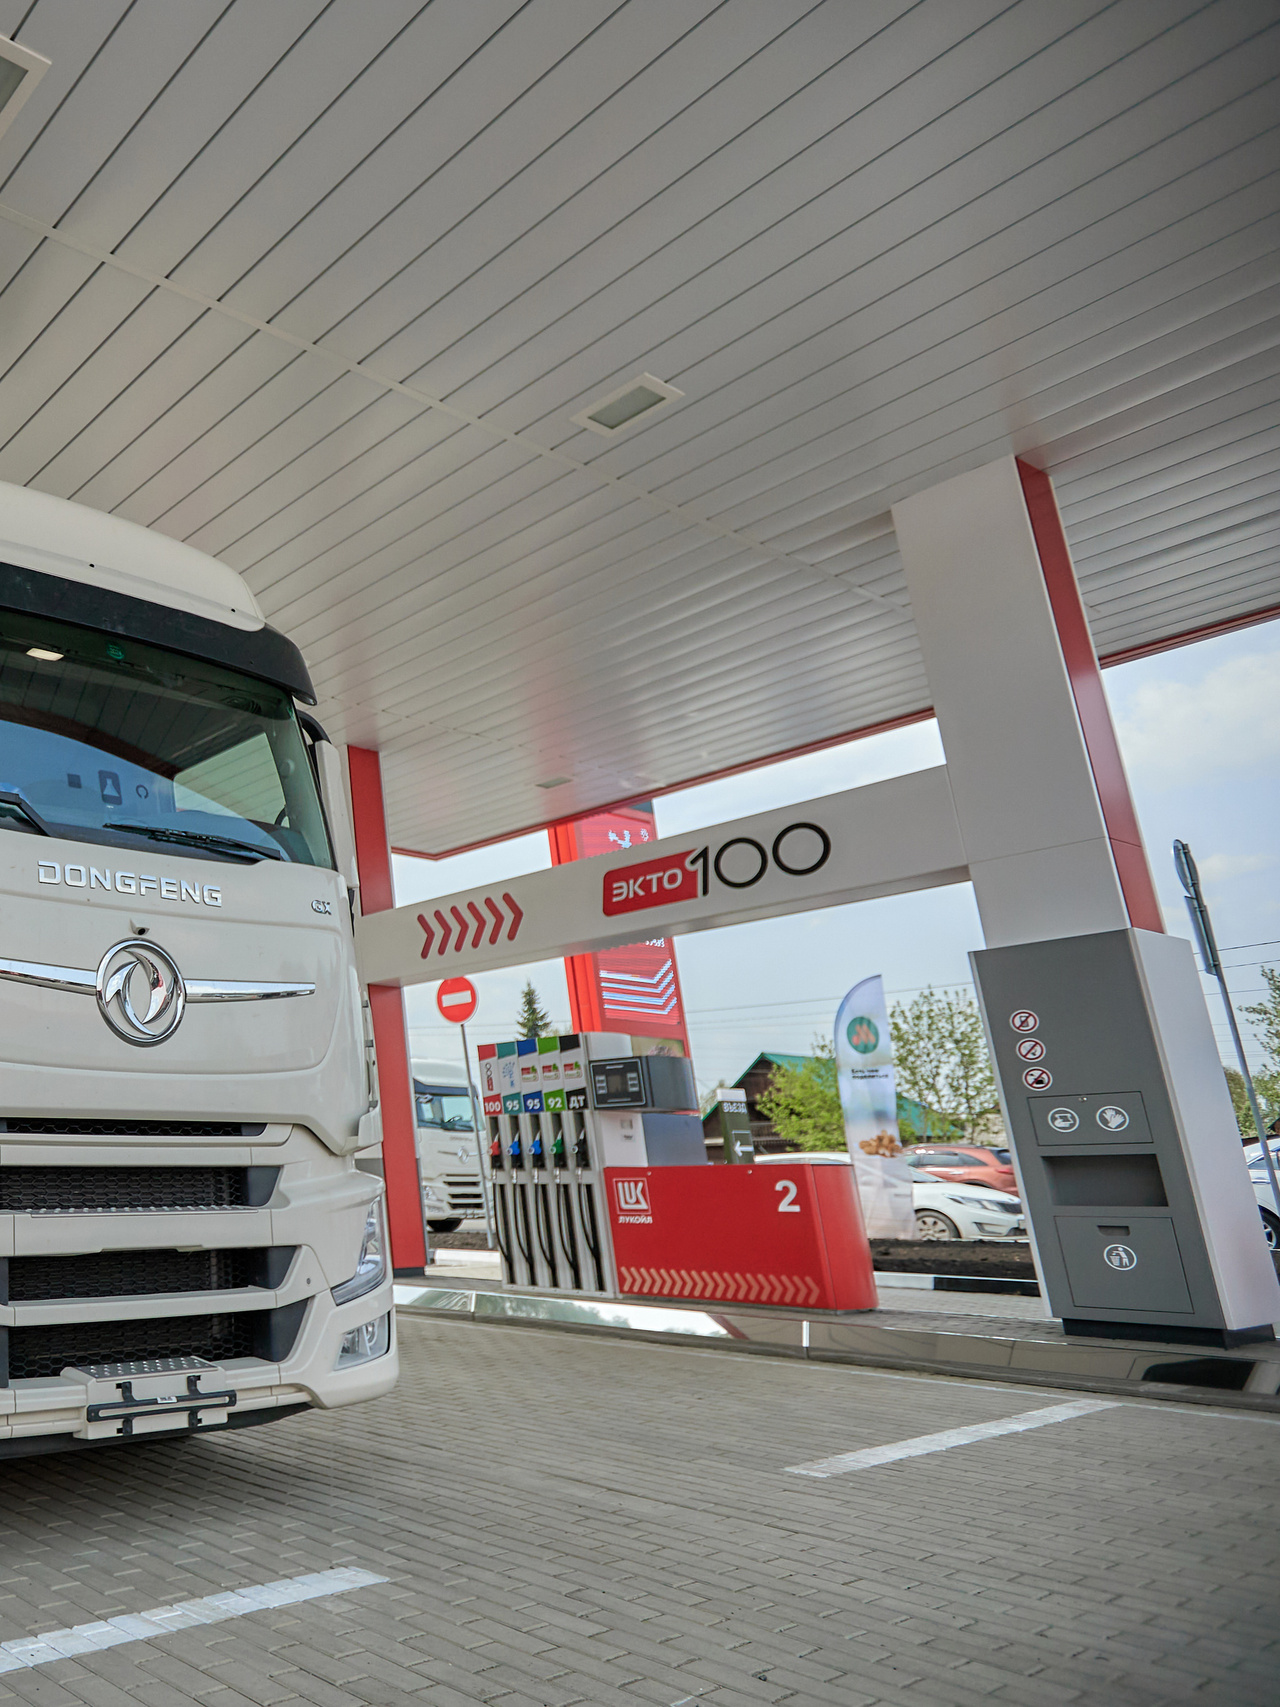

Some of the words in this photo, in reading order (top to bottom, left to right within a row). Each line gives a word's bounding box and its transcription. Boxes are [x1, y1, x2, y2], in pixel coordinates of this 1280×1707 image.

[612, 867, 683, 903] ЭКТО
[689, 822, 831, 898] 100
[37, 860, 223, 908] DONGFENG
[484, 1101, 501, 1113] 100
[505, 1099, 520, 1111] 95
[526, 1098, 541, 1110] 95
[547, 1096, 562, 1109] 92
[569, 1095, 585, 1109] ДТ
[617, 1181, 649, 1210] LUK
[775, 1179, 801, 1212] 2
[618, 1214, 654, 1224] ЛУКОЙЛ
